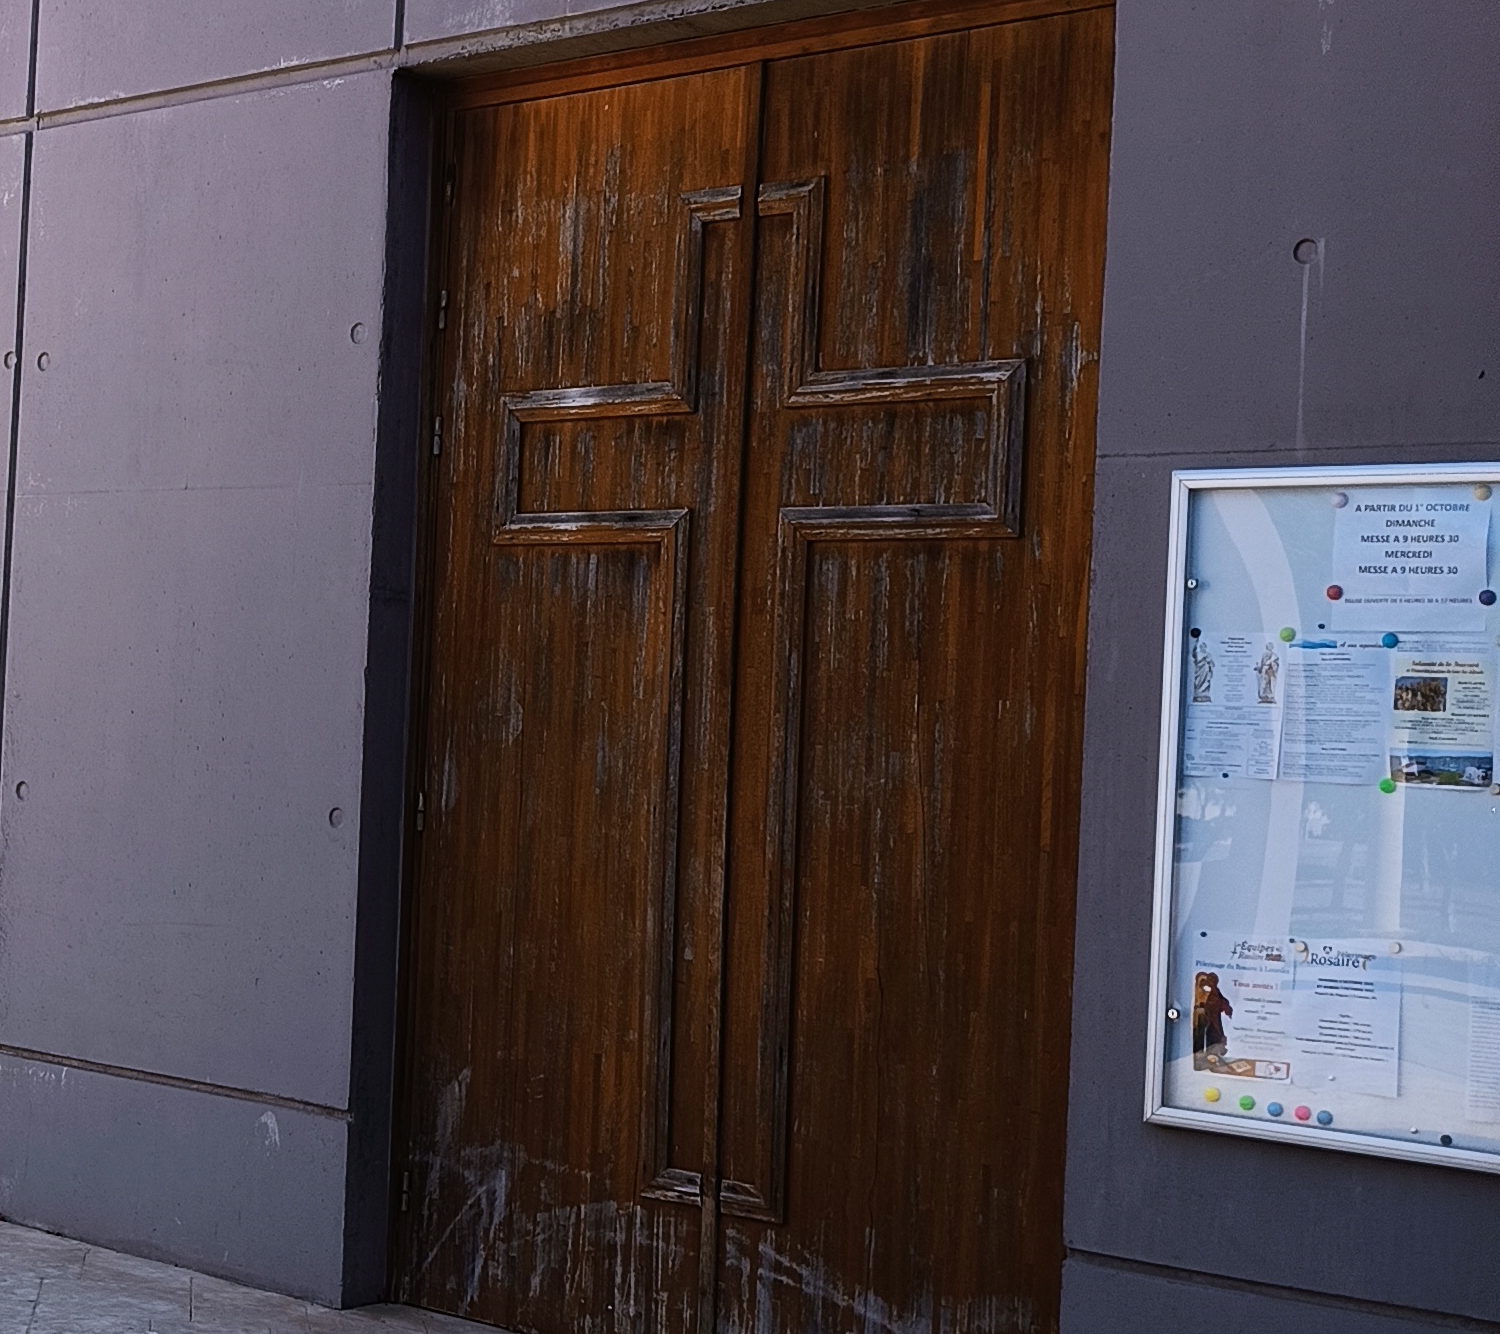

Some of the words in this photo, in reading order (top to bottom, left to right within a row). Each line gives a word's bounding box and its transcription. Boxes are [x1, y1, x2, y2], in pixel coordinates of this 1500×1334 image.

[1355, 504, 1362, 512] A
[1364, 504, 1396, 512] PARTIR
[1399, 504, 1413, 512] DU
[1425, 503, 1470, 512] OCTOBRE
[1385, 519, 1436, 528] DIMANCHE
[1360, 535, 1391, 543] MESSE
[1393, 535, 1400, 543] A
[1402, 535, 1409, 543] 9
[1410, 535, 1446, 543] HEURES
[1447, 535, 1460, 543] 30
[1384, 550, 1433, 559] MERCREDI
[1358, 565, 1389, 574] MESSE
[1390, 566, 1399, 575] A
[1400, 566, 1407, 575] 9
[1408, 566, 1445, 575] HEURES
[1446, 566, 1459, 575] 30
[1310, 952, 1360, 969] Rosaire
